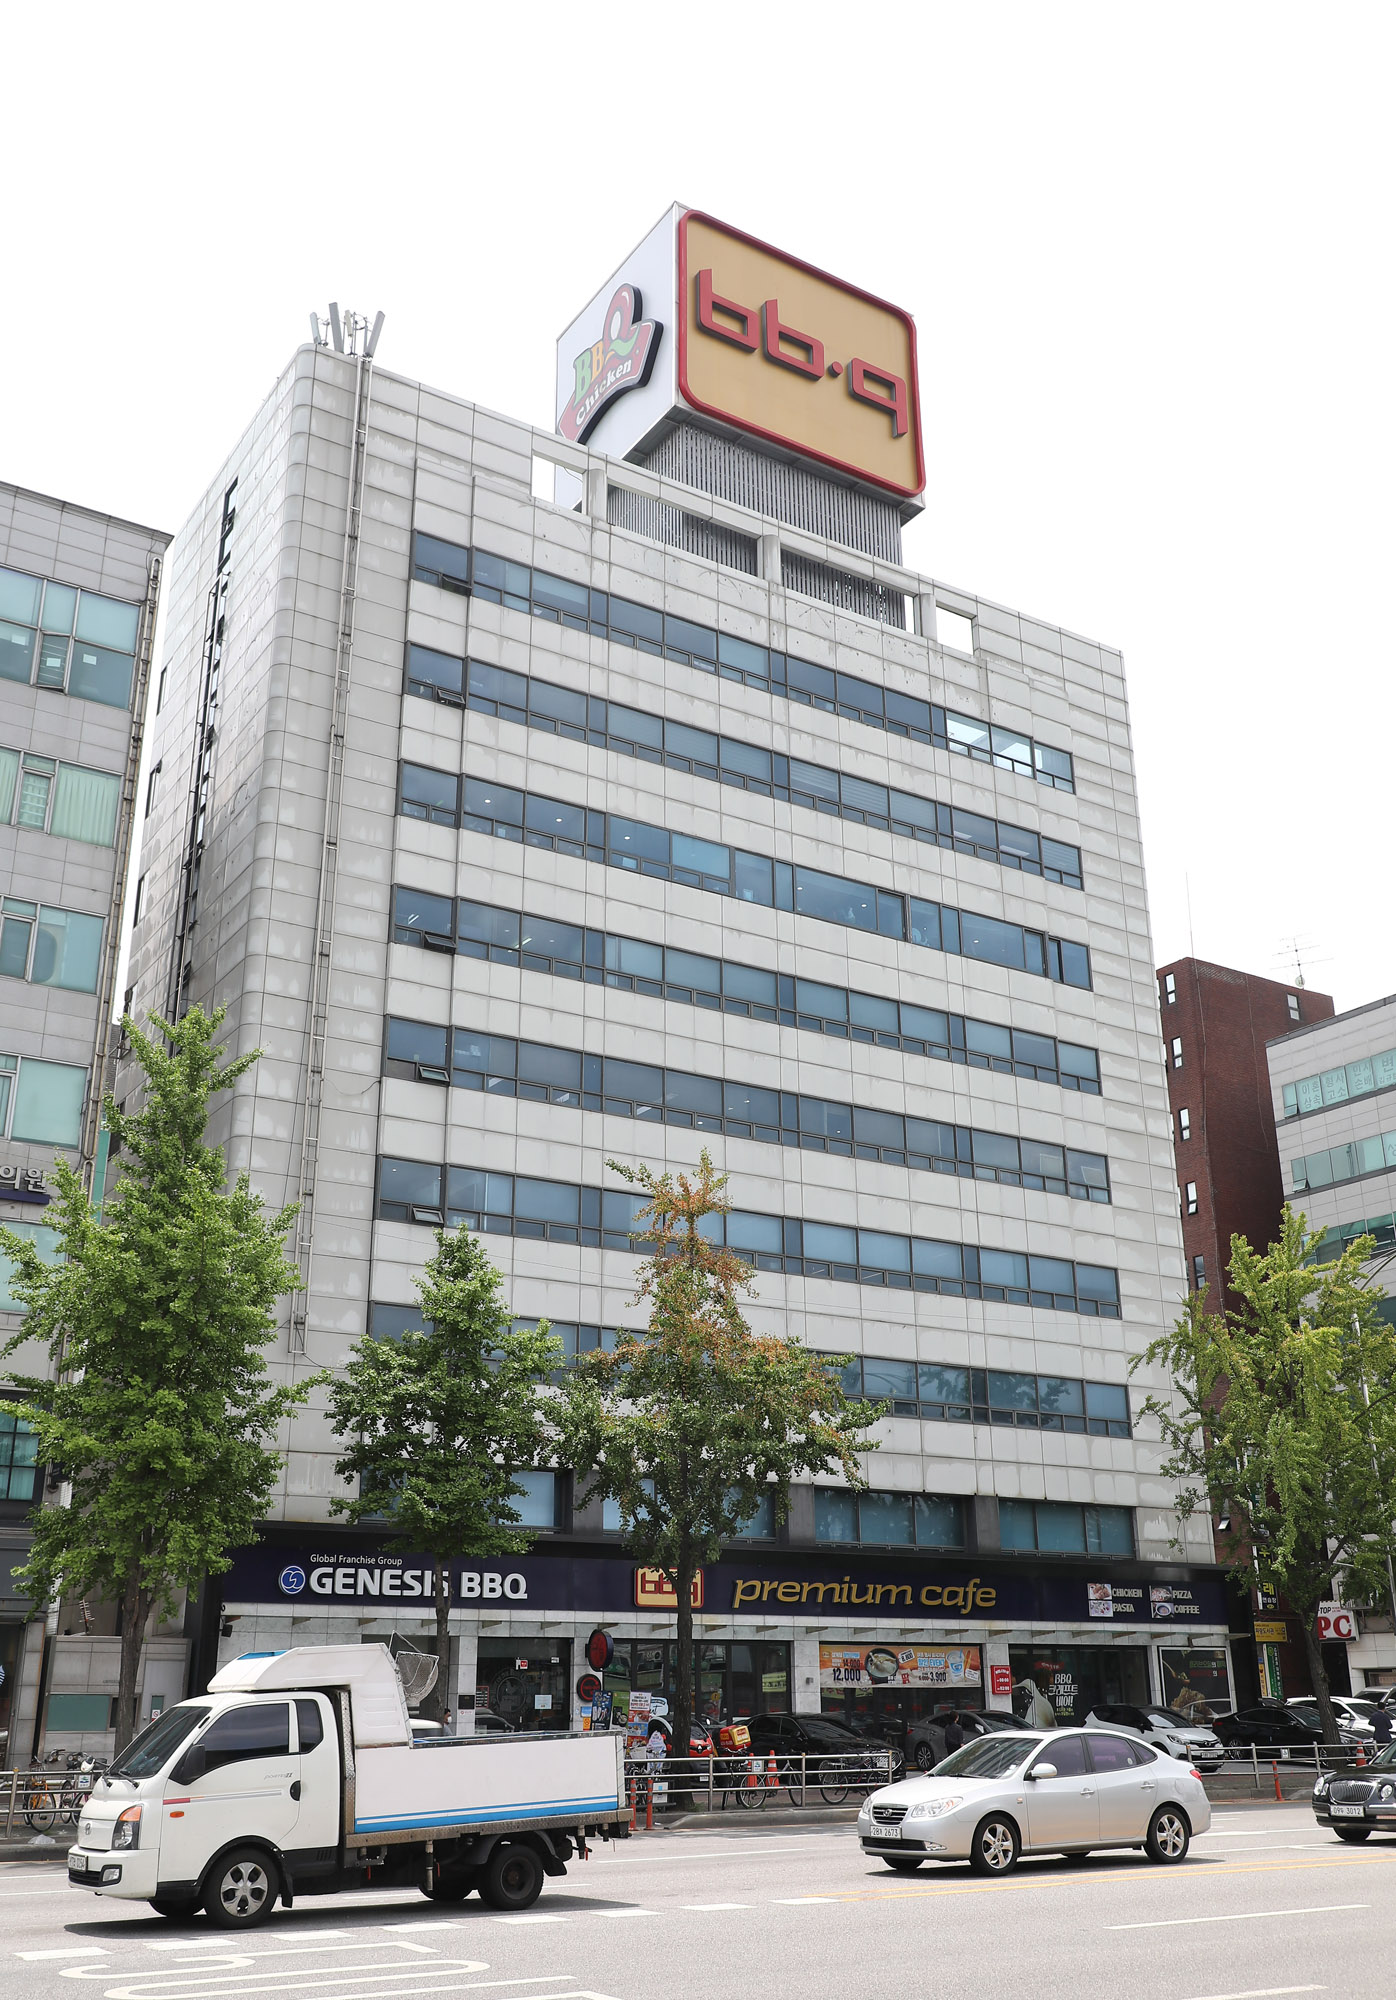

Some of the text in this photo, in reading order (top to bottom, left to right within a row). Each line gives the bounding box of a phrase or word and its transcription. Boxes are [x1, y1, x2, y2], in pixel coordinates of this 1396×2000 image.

[574, 283, 640, 408] BBQ
[1325, 1071, 1345, 1088] 형사
[1301, 1081, 1320, 1095] 이혼
[1327, 1087, 1347, 1101] 고소
[1304, 1094, 1321, 1110] 상속
[0, 1165, 48, 1193] 의원
[310, 1553, 403, 1567] Global Franchise Group
[460, 1571, 528, 1600] BBQ
[732, 1576, 997, 1615] premium cafe
[1112, 1588, 1143, 1598] CHICKEN
[1172, 1590, 1193, 1600] PIZZA
[1113, 1603, 1136, 1613] PASTA
[1174, 1605, 1200, 1615] COFFEE
[833, 1667, 861, 1682] 12,000
[929, 1671, 947, 1682] 3,900
[1055, 1673, 1072, 1684] BBQ
[1346, 1807, 1361, 1816] 3012
[884, 1828, 898, 1838] 2673
